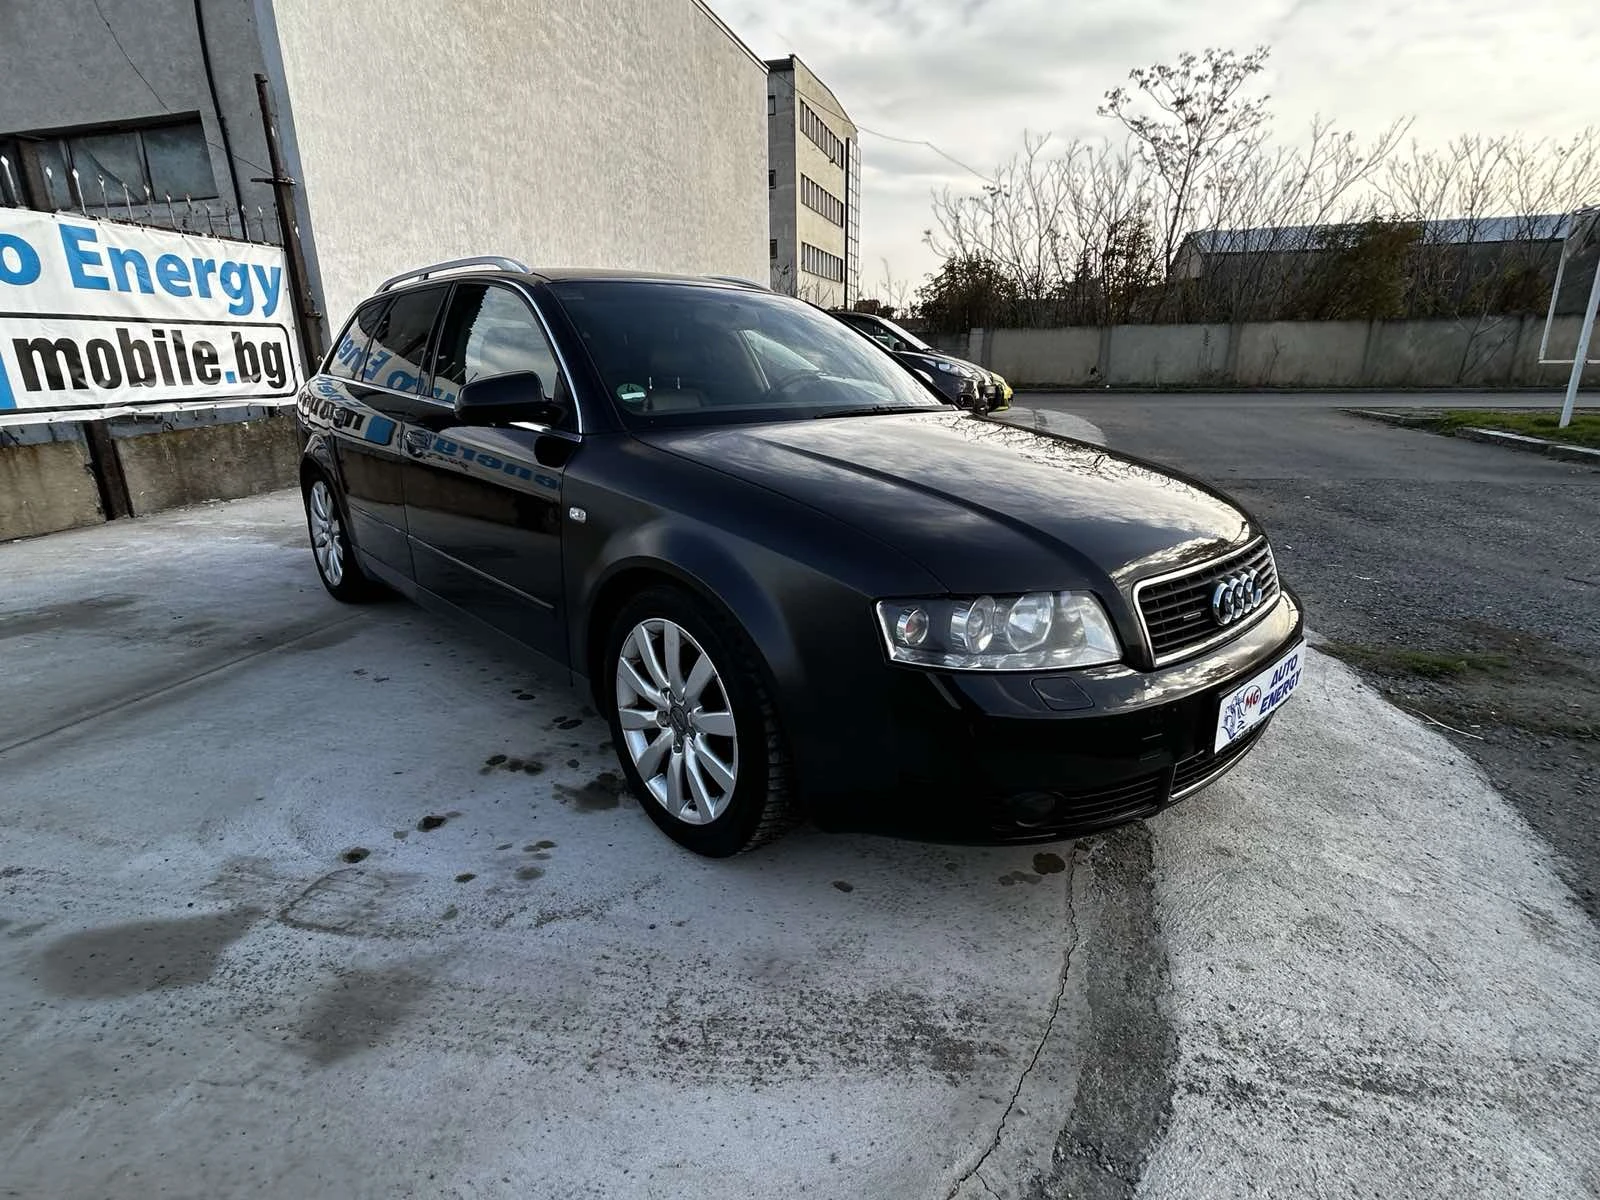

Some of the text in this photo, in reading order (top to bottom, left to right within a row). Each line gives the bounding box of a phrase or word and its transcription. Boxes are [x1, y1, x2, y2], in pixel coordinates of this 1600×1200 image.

[58, 223, 282, 318] Energy
[12, 327, 287, 391] mobile.bg
[1258, 667, 1302, 715] ENERGY
[1269, 653, 1298, 689] AUTO
[1244, 689, 1260, 708] MG
